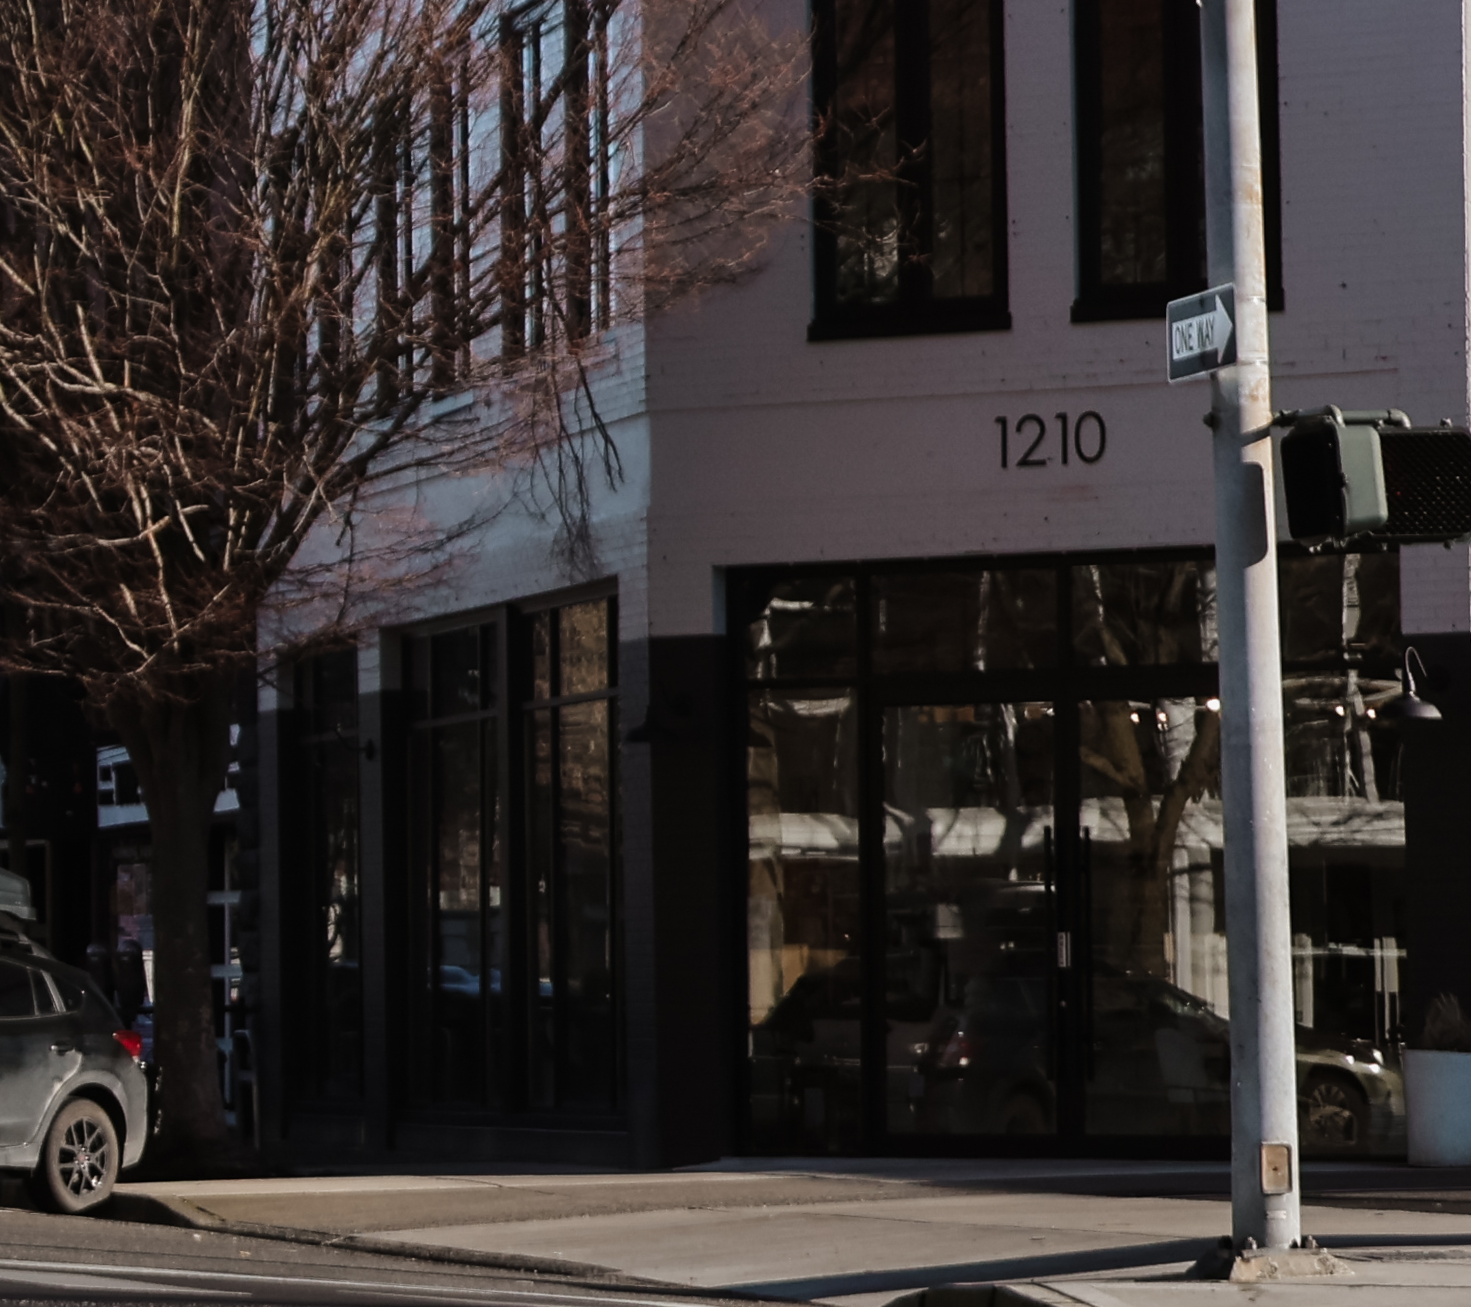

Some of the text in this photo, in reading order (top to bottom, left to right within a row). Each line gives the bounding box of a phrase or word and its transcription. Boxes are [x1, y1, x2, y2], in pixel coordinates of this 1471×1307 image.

[1174, 314, 1216, 355] ONE WAY
[994, 410, 1106, 468] 1210
